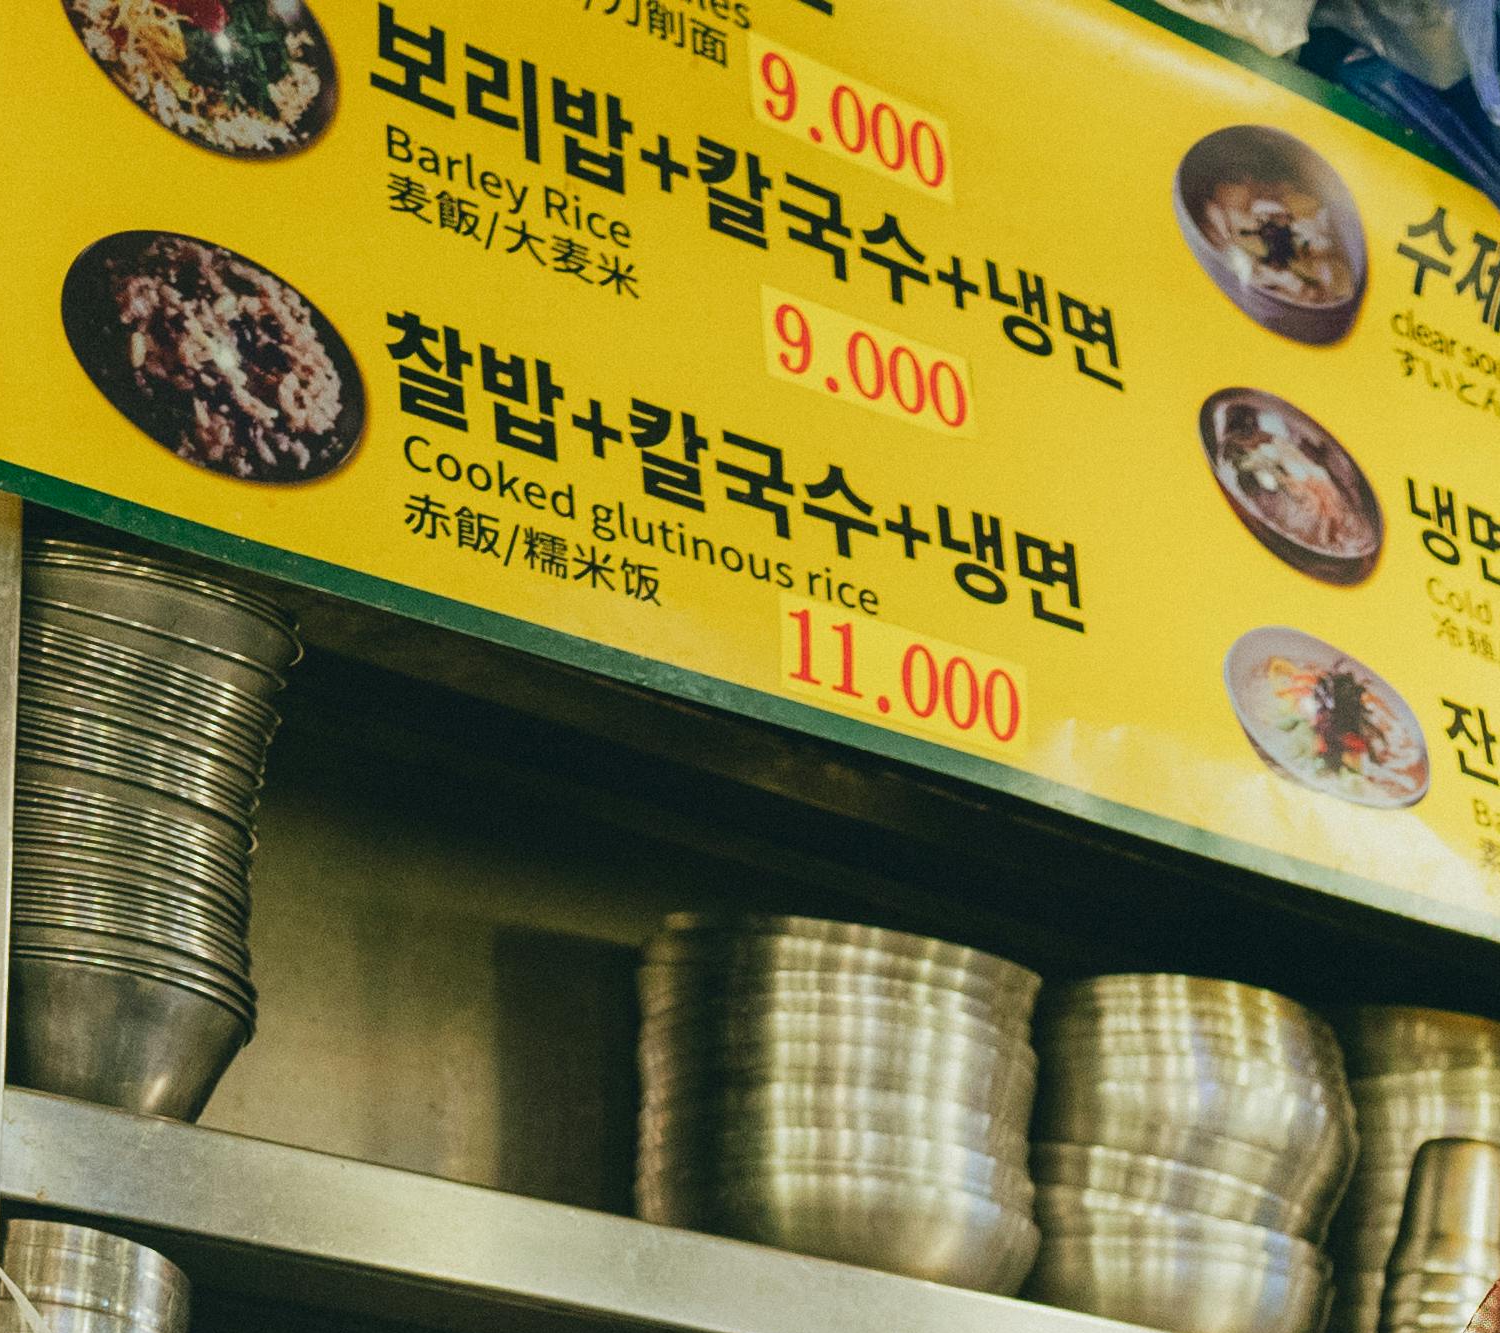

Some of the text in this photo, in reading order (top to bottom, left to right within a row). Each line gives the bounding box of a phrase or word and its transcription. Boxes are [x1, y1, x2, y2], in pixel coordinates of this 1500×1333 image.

[385, 124, 632, 248] Barley Rice
[760, 51, 946, 189] 9.000
[774, 303, 968, 428] 9.000
[403, 435, 880, 616] Cooked glutinous rice
[787, 609, 1020, 743] 11.000
